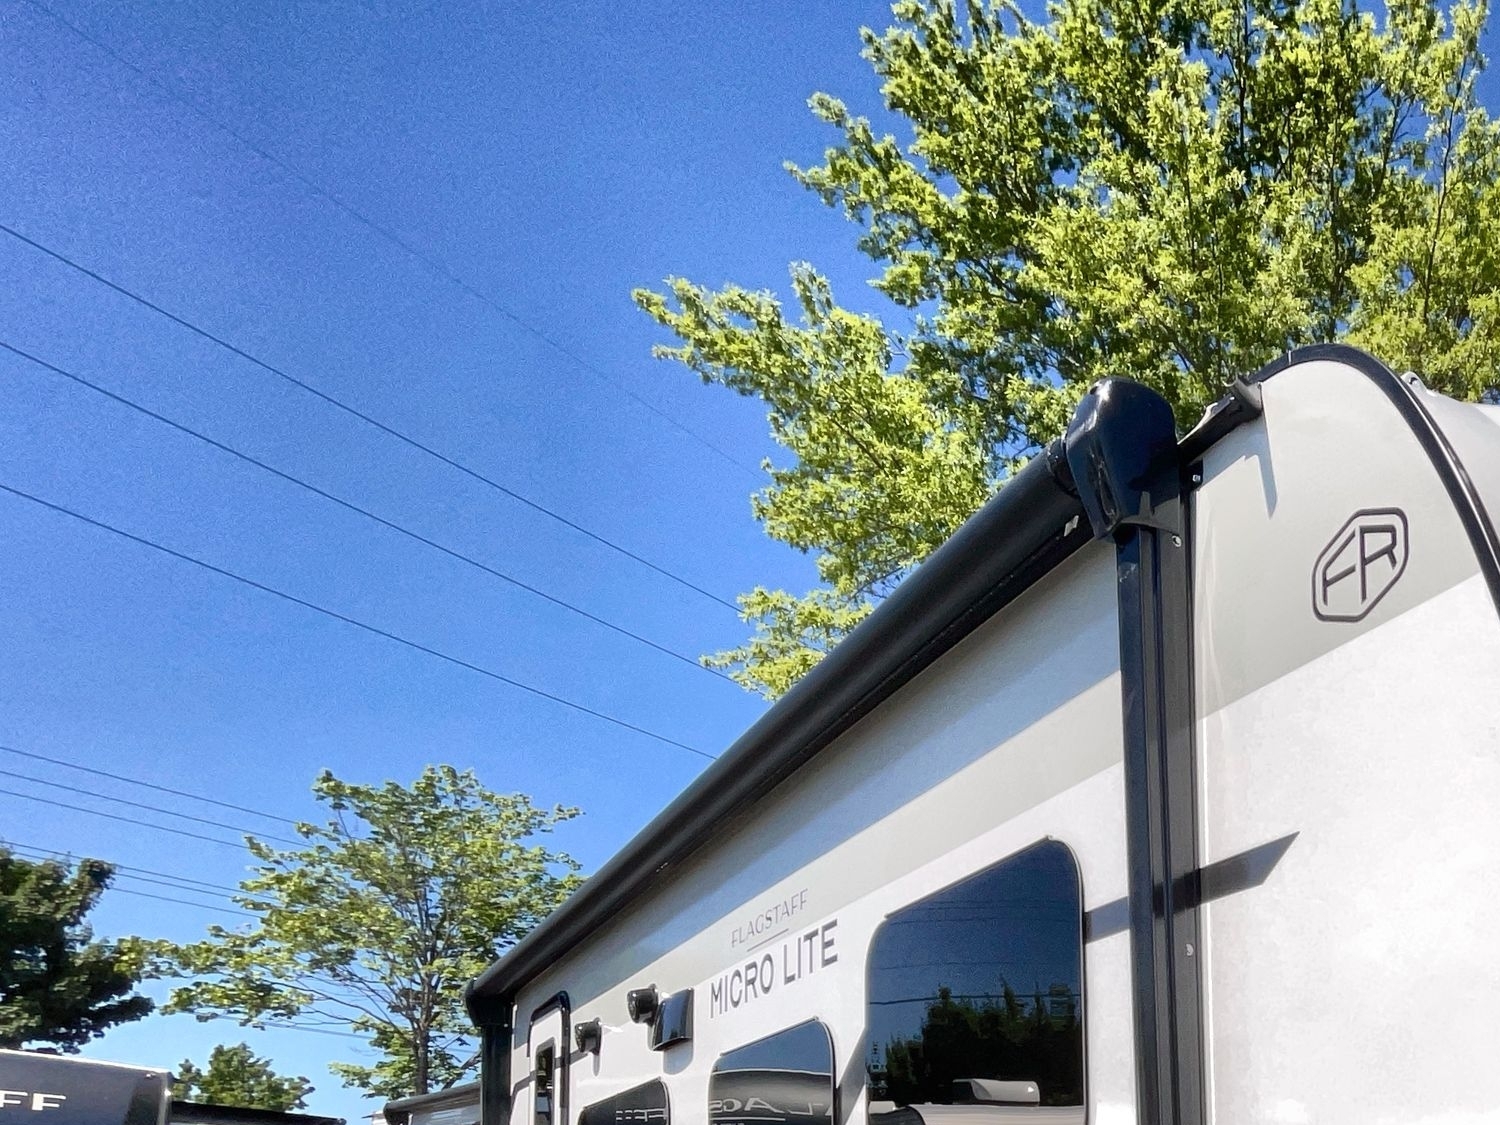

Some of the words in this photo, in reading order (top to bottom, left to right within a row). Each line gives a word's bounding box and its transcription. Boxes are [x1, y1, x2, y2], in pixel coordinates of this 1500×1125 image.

[731, 888, 809, 949] FLAGSTAFF
[710, 953, 774, 1019] MICRO
[783, 918, 839, 985] LITE
